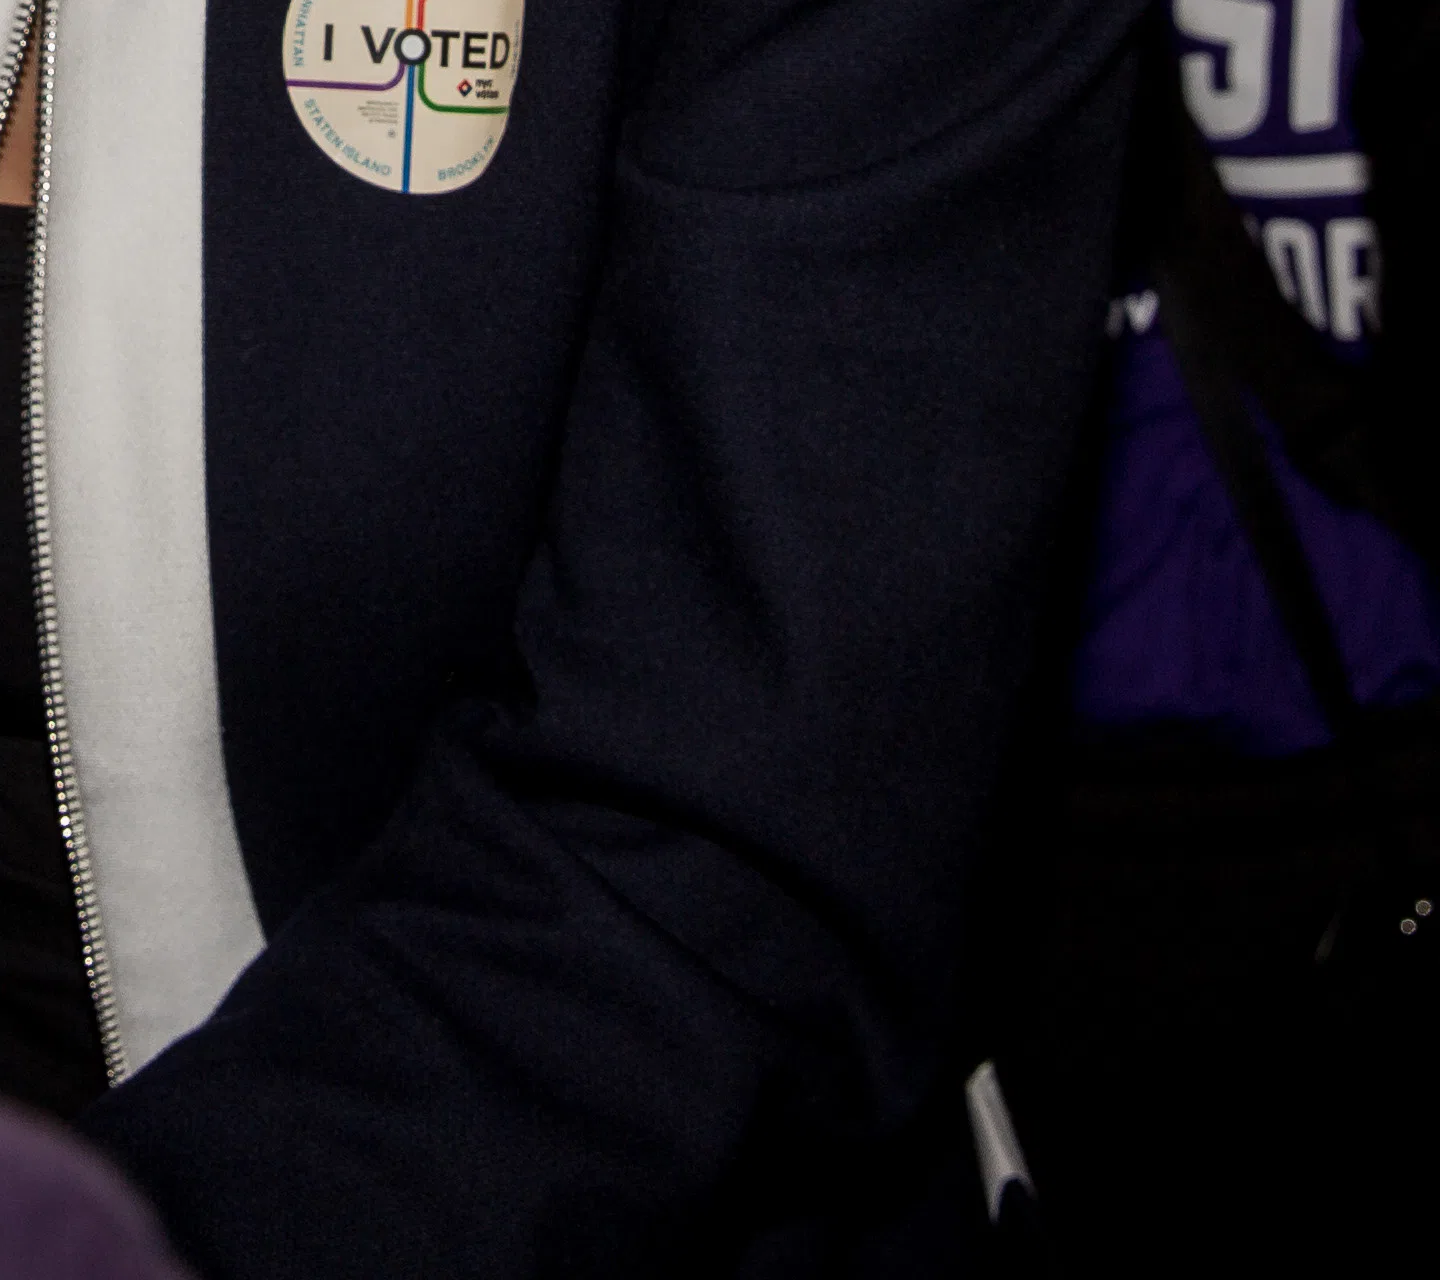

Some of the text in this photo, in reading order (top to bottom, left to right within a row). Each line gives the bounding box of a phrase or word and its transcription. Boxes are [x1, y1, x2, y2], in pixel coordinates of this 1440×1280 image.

[323, 23, 334, 61] I
[360, 25, 511, 70] VOTED
[303, 98, 345, 154] STATEN
[340, 142, 393, 178] ISLAND
[437, 136, 496, 181] BROOKLYN
